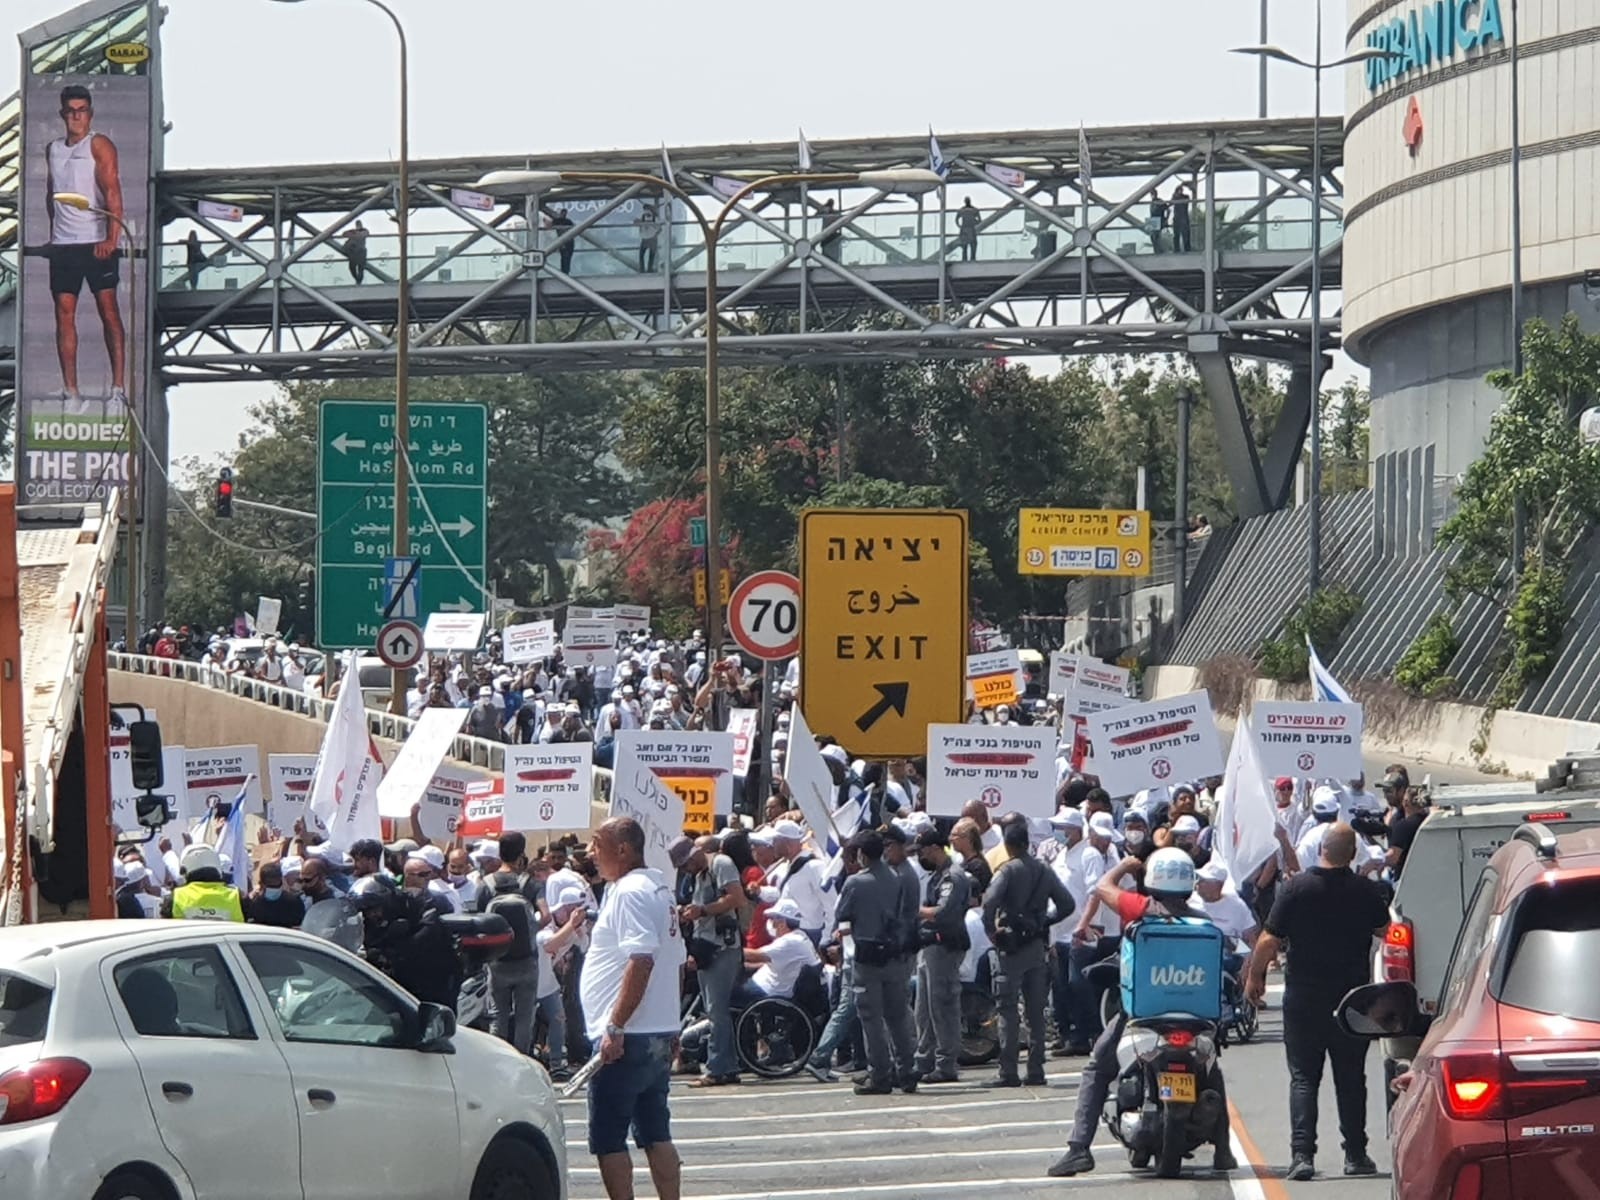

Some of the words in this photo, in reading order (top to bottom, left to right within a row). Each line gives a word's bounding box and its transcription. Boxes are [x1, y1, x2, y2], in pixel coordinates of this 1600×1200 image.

[1365, 0, 1504, 90] URBANICA
[379, 414, 432, 428] השום
[34, 421, 125, 441] HOODIES
[26, 451, 77, 480] THE
[85, 451, 138, 481] PRO
[452, 461, 475, 475] Rd
[25, 483, 115, 499] COLLECTIO
[1030, 513, 1075, 523] עזריאלי
[1079, 513, 1109, 523] מרכז
[354, 541, 391, 558] Begi
[410, 543, 432, 555] Rd
[828, 537, 941, 561] יציאה
[1060, 550, 1092, 561] כניסה
[847, 584, 921, 614] خروج
[748, 599, 797, 634] 70
[836, 635, 928, 660] EXIT
[1158, 704, 1197, 720] הטיפול
[1132, 714, 1156, 725] בנכי
[1267, 714, 1325, 725] משאירים
[1329, 715, 1346, 726] לא
[975, 737, 998, 748] בנכי
[1183, 733, 1201, 744] של
[1261, 732, 1302, 743] מאחור
[1306, 733, 1352, 744] פצועים
[674, 744, 688, 752] כל
[1001, 738, 1042, 749] הטיפול
[1149, 737, 1181, 752] מדינת
[1110, 745, 1146, 760] ישראל
[554, 755, 582, 765] הטיפול
[944, 766, 982, 777] ישראל
[984, 767, 1017, 778] מדינת
[1021, 768, 1039, 779] של
[567, 783, 580, 792] של
[1150, 964, 1206, 986] Wolt
[1520, 1124, 1595, 1137] SELTOS
